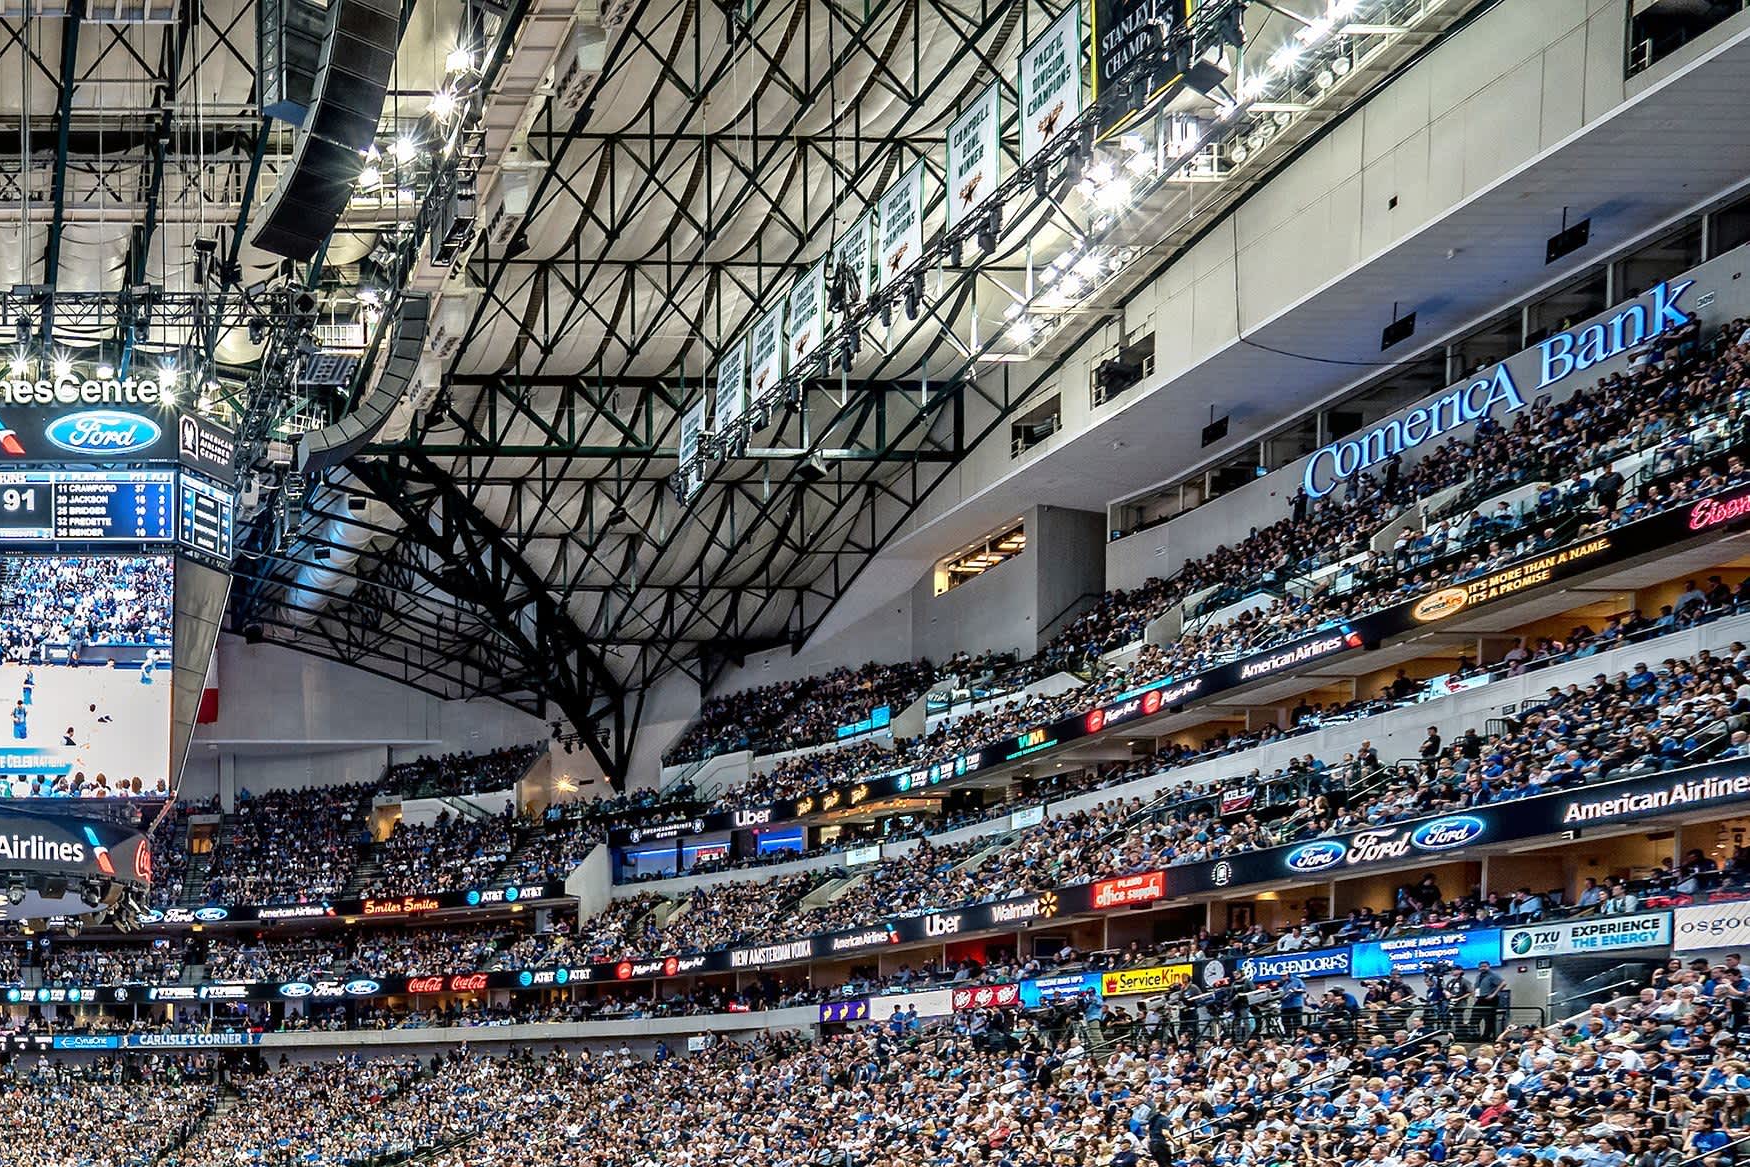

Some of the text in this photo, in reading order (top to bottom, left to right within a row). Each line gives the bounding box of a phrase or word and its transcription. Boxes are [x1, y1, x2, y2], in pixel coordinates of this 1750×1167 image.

[1033, 30, 1064, 74] PACIFIC
[1032, 50, 1065, 94] DIVISION
[1027, 63, 1071, 118] CHAMPIONS
[953, 104, 990, 148] CAMPBELL
[1536, 279, 1697, 391] Bank
[69, 417, 138, 448] Ford
[200, 430, 234, 451] AMERICAN
[57, 485, 117, 493] 11 CRAWFORD
[3, 489, 36, 511] 91
[68, 496, 109, 504] JACKSON
[68, 507, 107, 515] BRIDGES
[68, 517, 112, 526] FREDETTE
[68, 528, 104, 537] BENDER
[1468, 577, 1487, 596] IT'S
[1488, 567, 1523, 590] MORE
[1523, 558, 1556, 578] THAN
[1468, 569, 1551, 605] IT'S PROMISE
[1240, 637, 1342, 680] American Airlines
[735, 809, 771, 826] Uber
[1563, 791, 1669, 824] American
[1427, 822, 1468, 845] Ford
[1346, 828, 1412, 863] Ford
[1297, 849, 1334, 868] Ford
[481, 887, 543, 901] AT&T AT&T
[1096, 879, 1160, 907] office supply
[163, 908, 195, 922] Ford
[258, 905, 324, 919] American Airlines
[363, 898, 438, 915] 5miles 5miles
[992, 901, 1040, 923] Walmart
[925, 915, 961, 937] Uber
[1571, 918, 1660, 938] EXPERIENCE
[1534, 931, 1659, 949] TXU THE ENERGY
[731, 951, 749, 967] NEW
[749, 944, 791, 966] AMSTERDAM
[1415, 947, 1459, 960] Thompson
[75, 1037, 107, 1046] CyrusOne
[139, 1033, 243, 1046] CARLISLE'S CORNER
